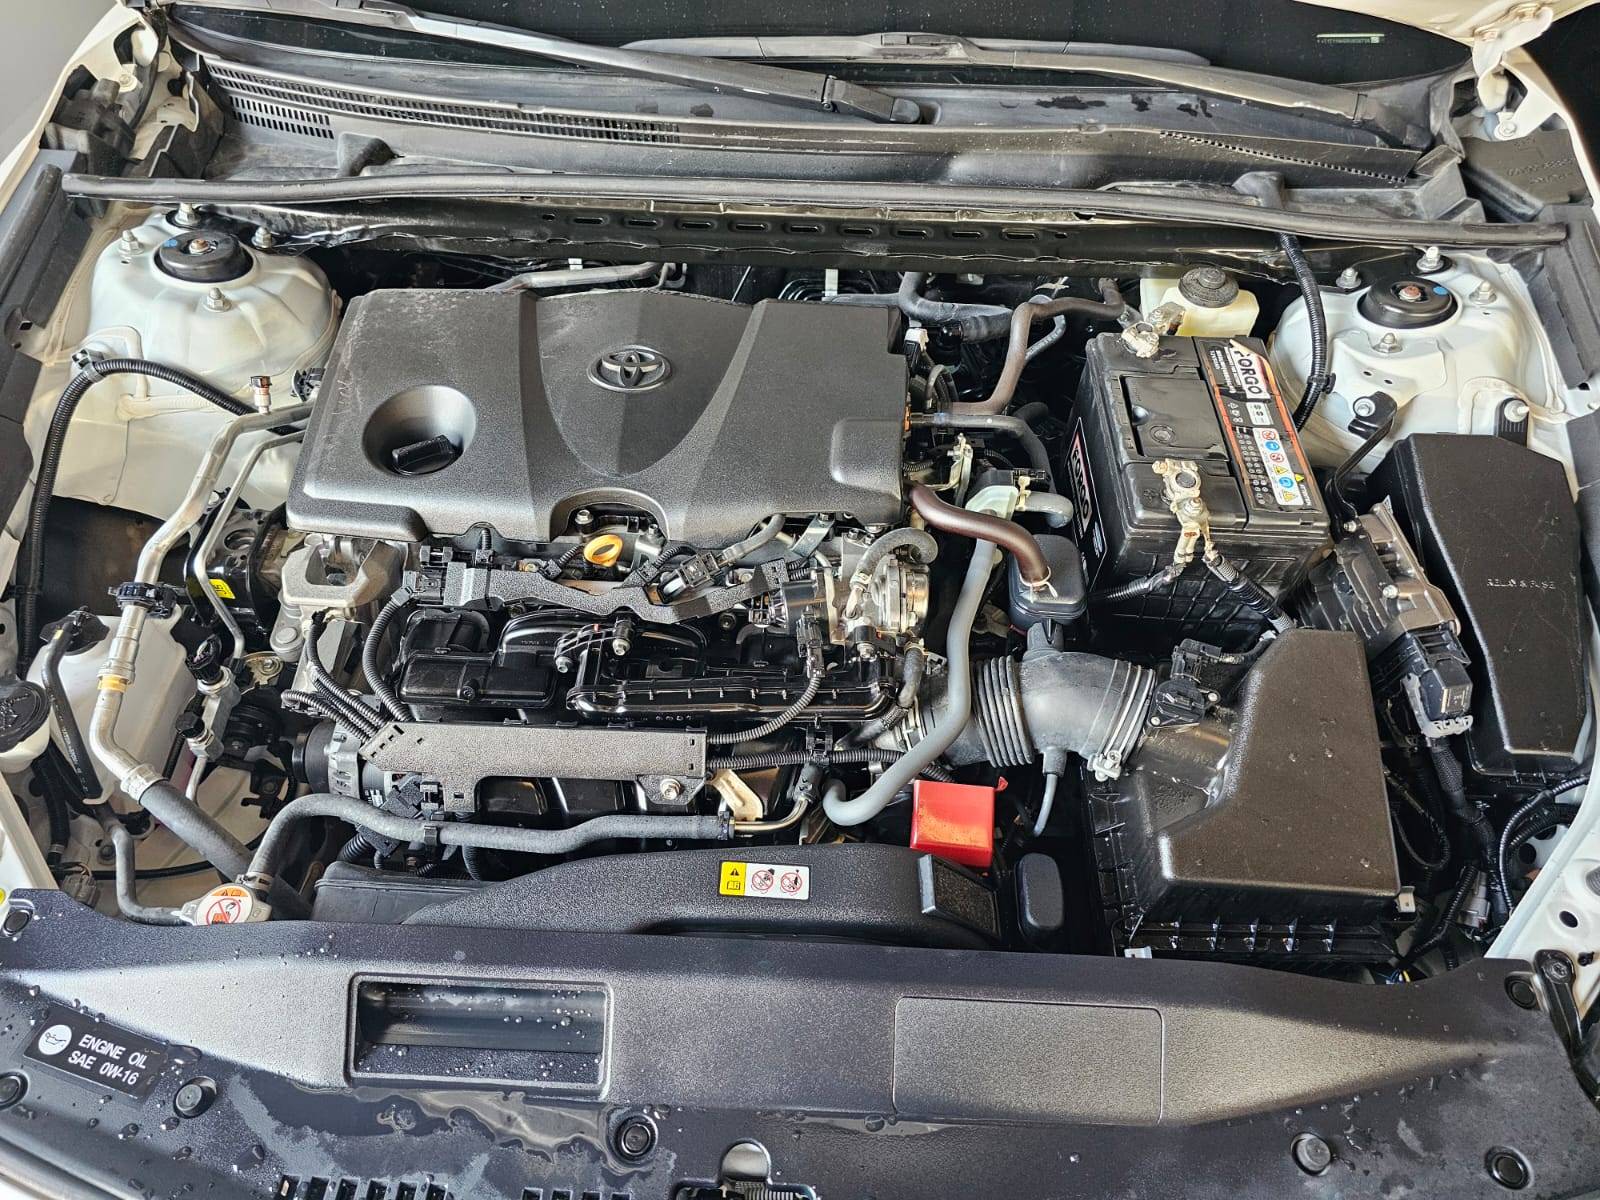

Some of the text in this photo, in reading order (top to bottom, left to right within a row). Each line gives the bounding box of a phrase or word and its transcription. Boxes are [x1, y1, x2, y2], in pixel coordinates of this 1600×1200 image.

[67, 1050, 140, 1086] SAE 0W-16
[78, 1033, 148, 1070] ENGINE OIL
